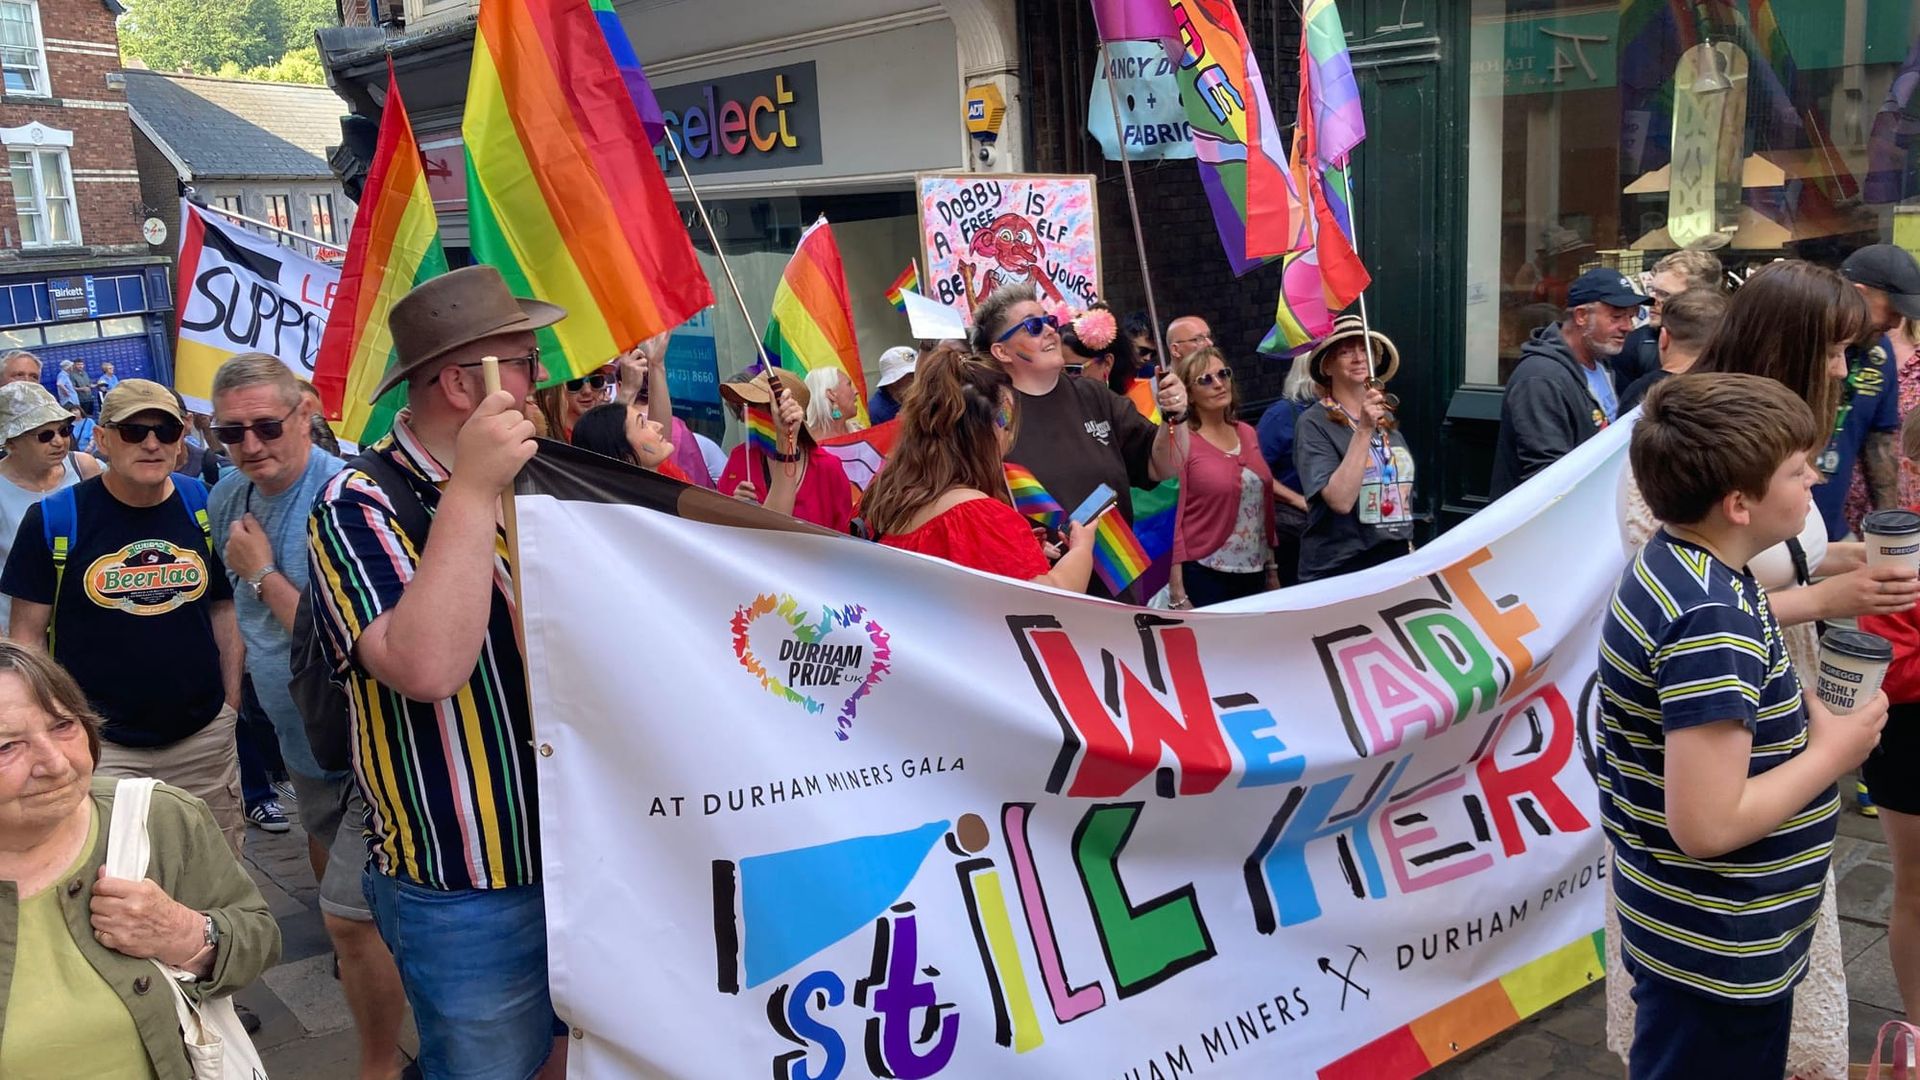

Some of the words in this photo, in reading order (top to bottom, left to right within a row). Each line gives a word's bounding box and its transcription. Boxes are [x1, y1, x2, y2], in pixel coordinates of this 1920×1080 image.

[969, 103, 985, 117] ADT
[934, 231, 952, 259] A
[959, 208, 996, 244] FREE
[1036, 217, 1068, 243] ELF
[55, 286, 84, 297] Birkett
[85, 277, 95, 298] LET
[937, 274, 965, 306] BE
[1046, 259, 1098, 307] YOURSE
[88, 300, 98, 315] TO
[181, 265, 328, 372] SUPPO
[104, 566, 200, 591] Beerlao
[779, 639, 863, 668] DURHAM
[788, 661, 844, 688] PRIDE
[844, 674, 863, 684] UK
[1817, 675, 1859, 698] FRESHLY
[1825, 666, 1862, 682] GREGGS
[1006, 614, 1306, 798] WE
[648, 796, 685, 817] AT
[703, 775, 822, 816] DURHAM
[826, 763, 893, 793] MINERS
[901, 756, 966, 778] GALA
[1243, 682, 1598, 935] HER
[1200, 986, 1310, 1063] MINERS
[1396, 900, 1529, 972] DURHAM
[1539, 855, 1606, 912] PRIDE
